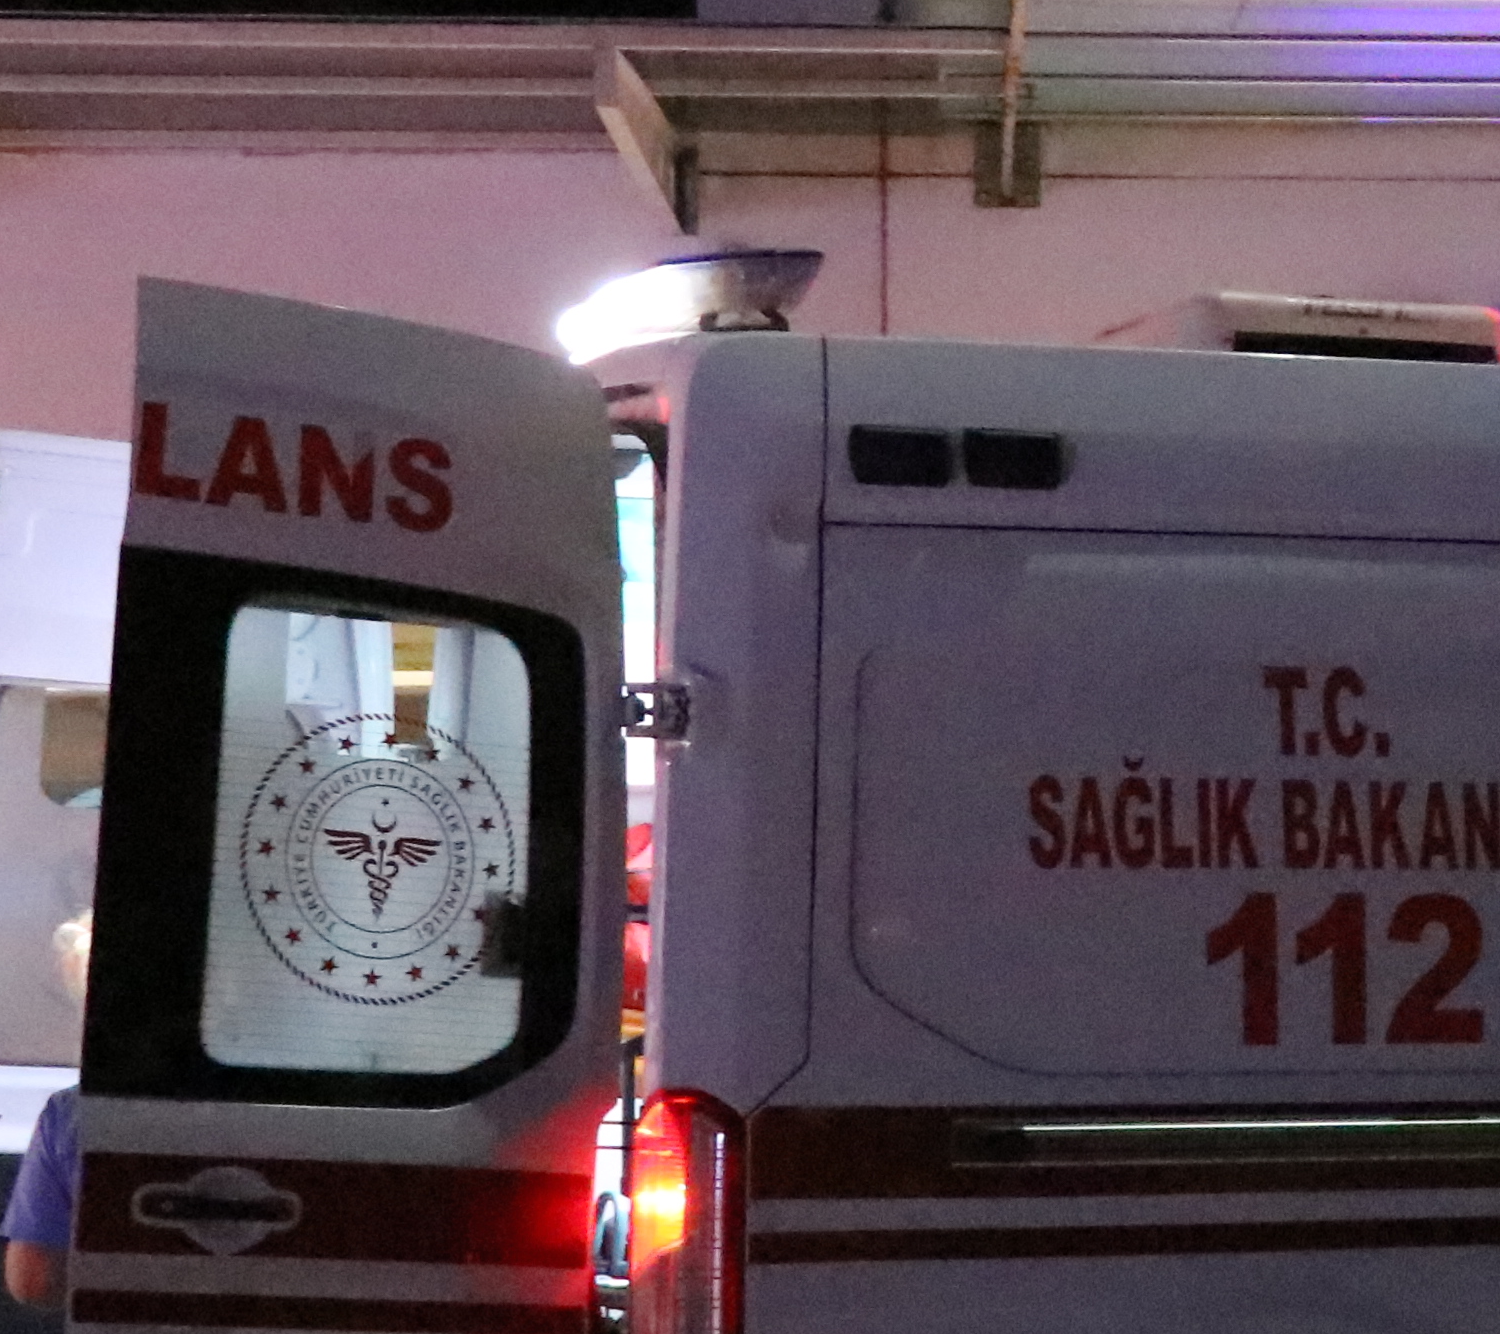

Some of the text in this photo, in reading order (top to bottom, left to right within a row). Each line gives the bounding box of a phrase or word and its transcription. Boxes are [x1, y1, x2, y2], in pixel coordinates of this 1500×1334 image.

[132, 400, 453, 532] LANS
[1260, 666, 1392, 758] T.C.
[1027, 754, 1260, 869] SAĞLIK
[1206, 892, 1486, 1047] 112
